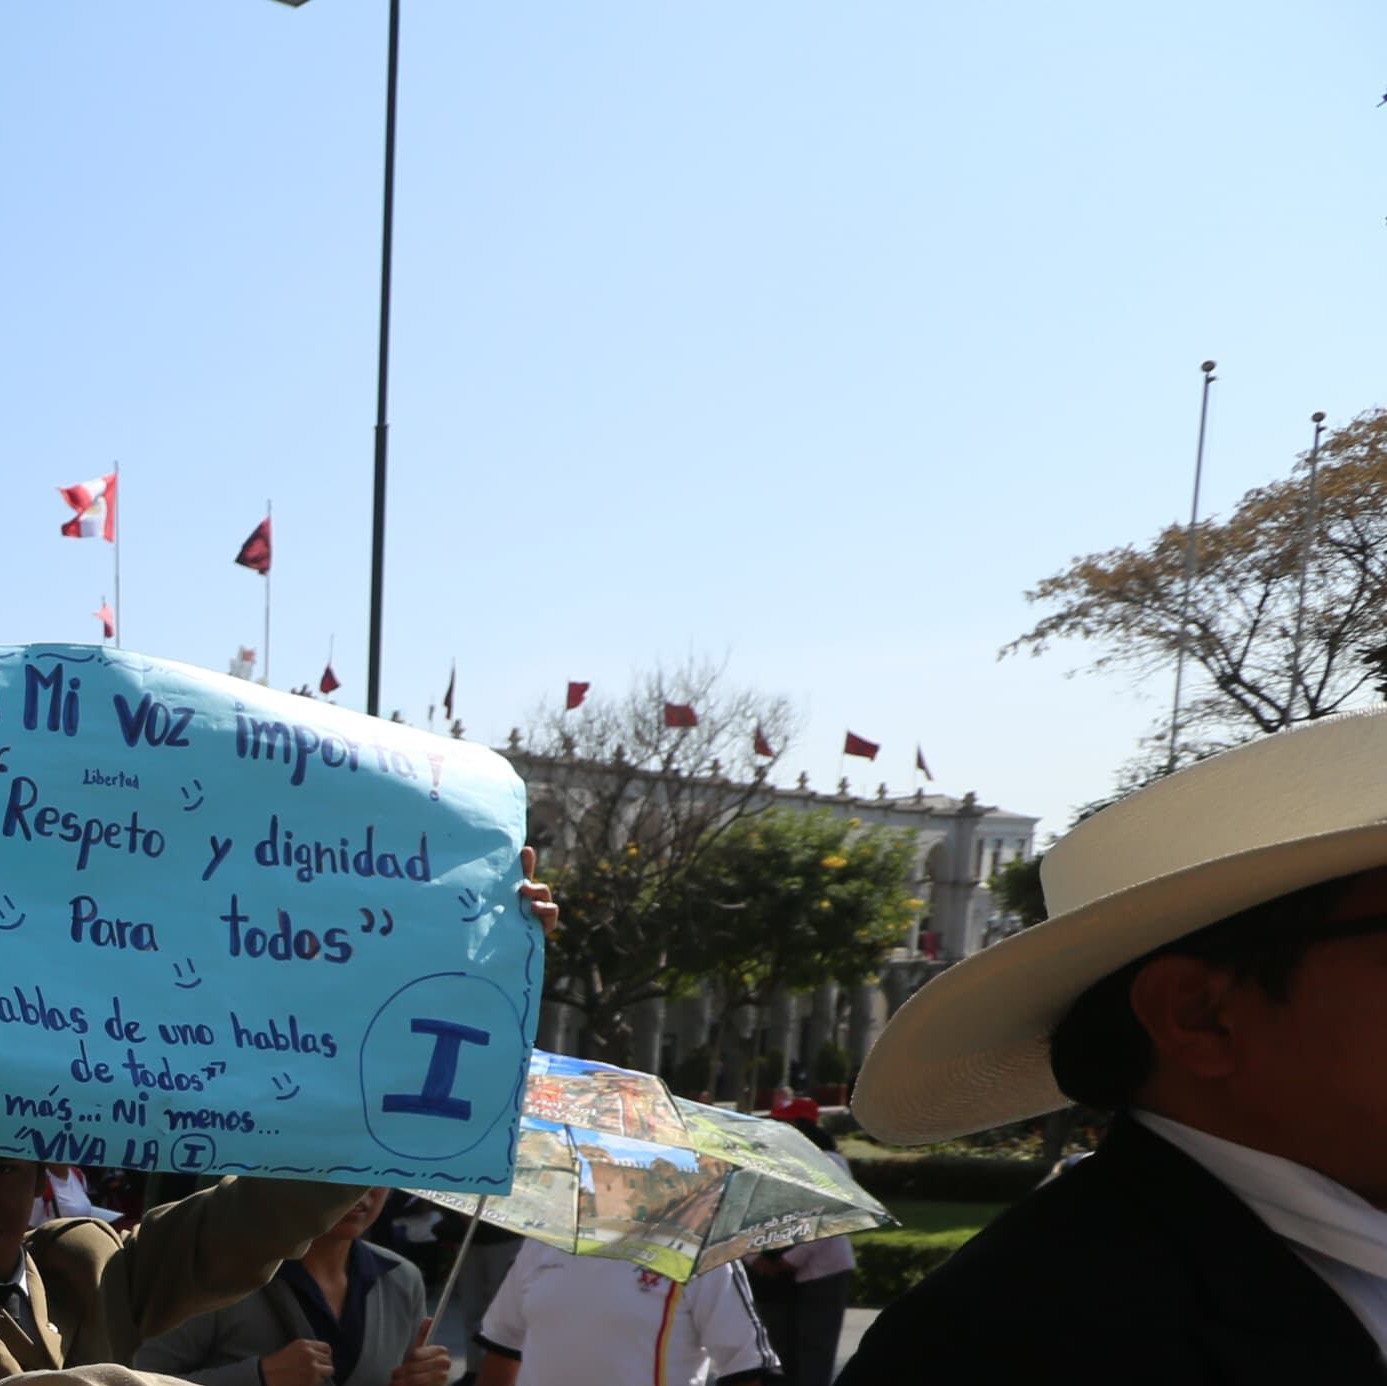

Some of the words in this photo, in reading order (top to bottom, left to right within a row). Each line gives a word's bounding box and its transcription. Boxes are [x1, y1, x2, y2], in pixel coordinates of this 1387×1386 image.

[201, 834, 233, 882] y
[254, 814, 431, 883] dignidad
[69, 895, 159, 951] Para
[104, 996, 147, 1043] de
[158, 1022, 214, 1045] uno
[230, 1011, 338, 1059] hablas
[70, 1039, 114, 1083] de
[381, 1017, 491, 1122] I
[112, 1091, 149, 1127] Ni
[121, 1138, 159, 1171] LA
